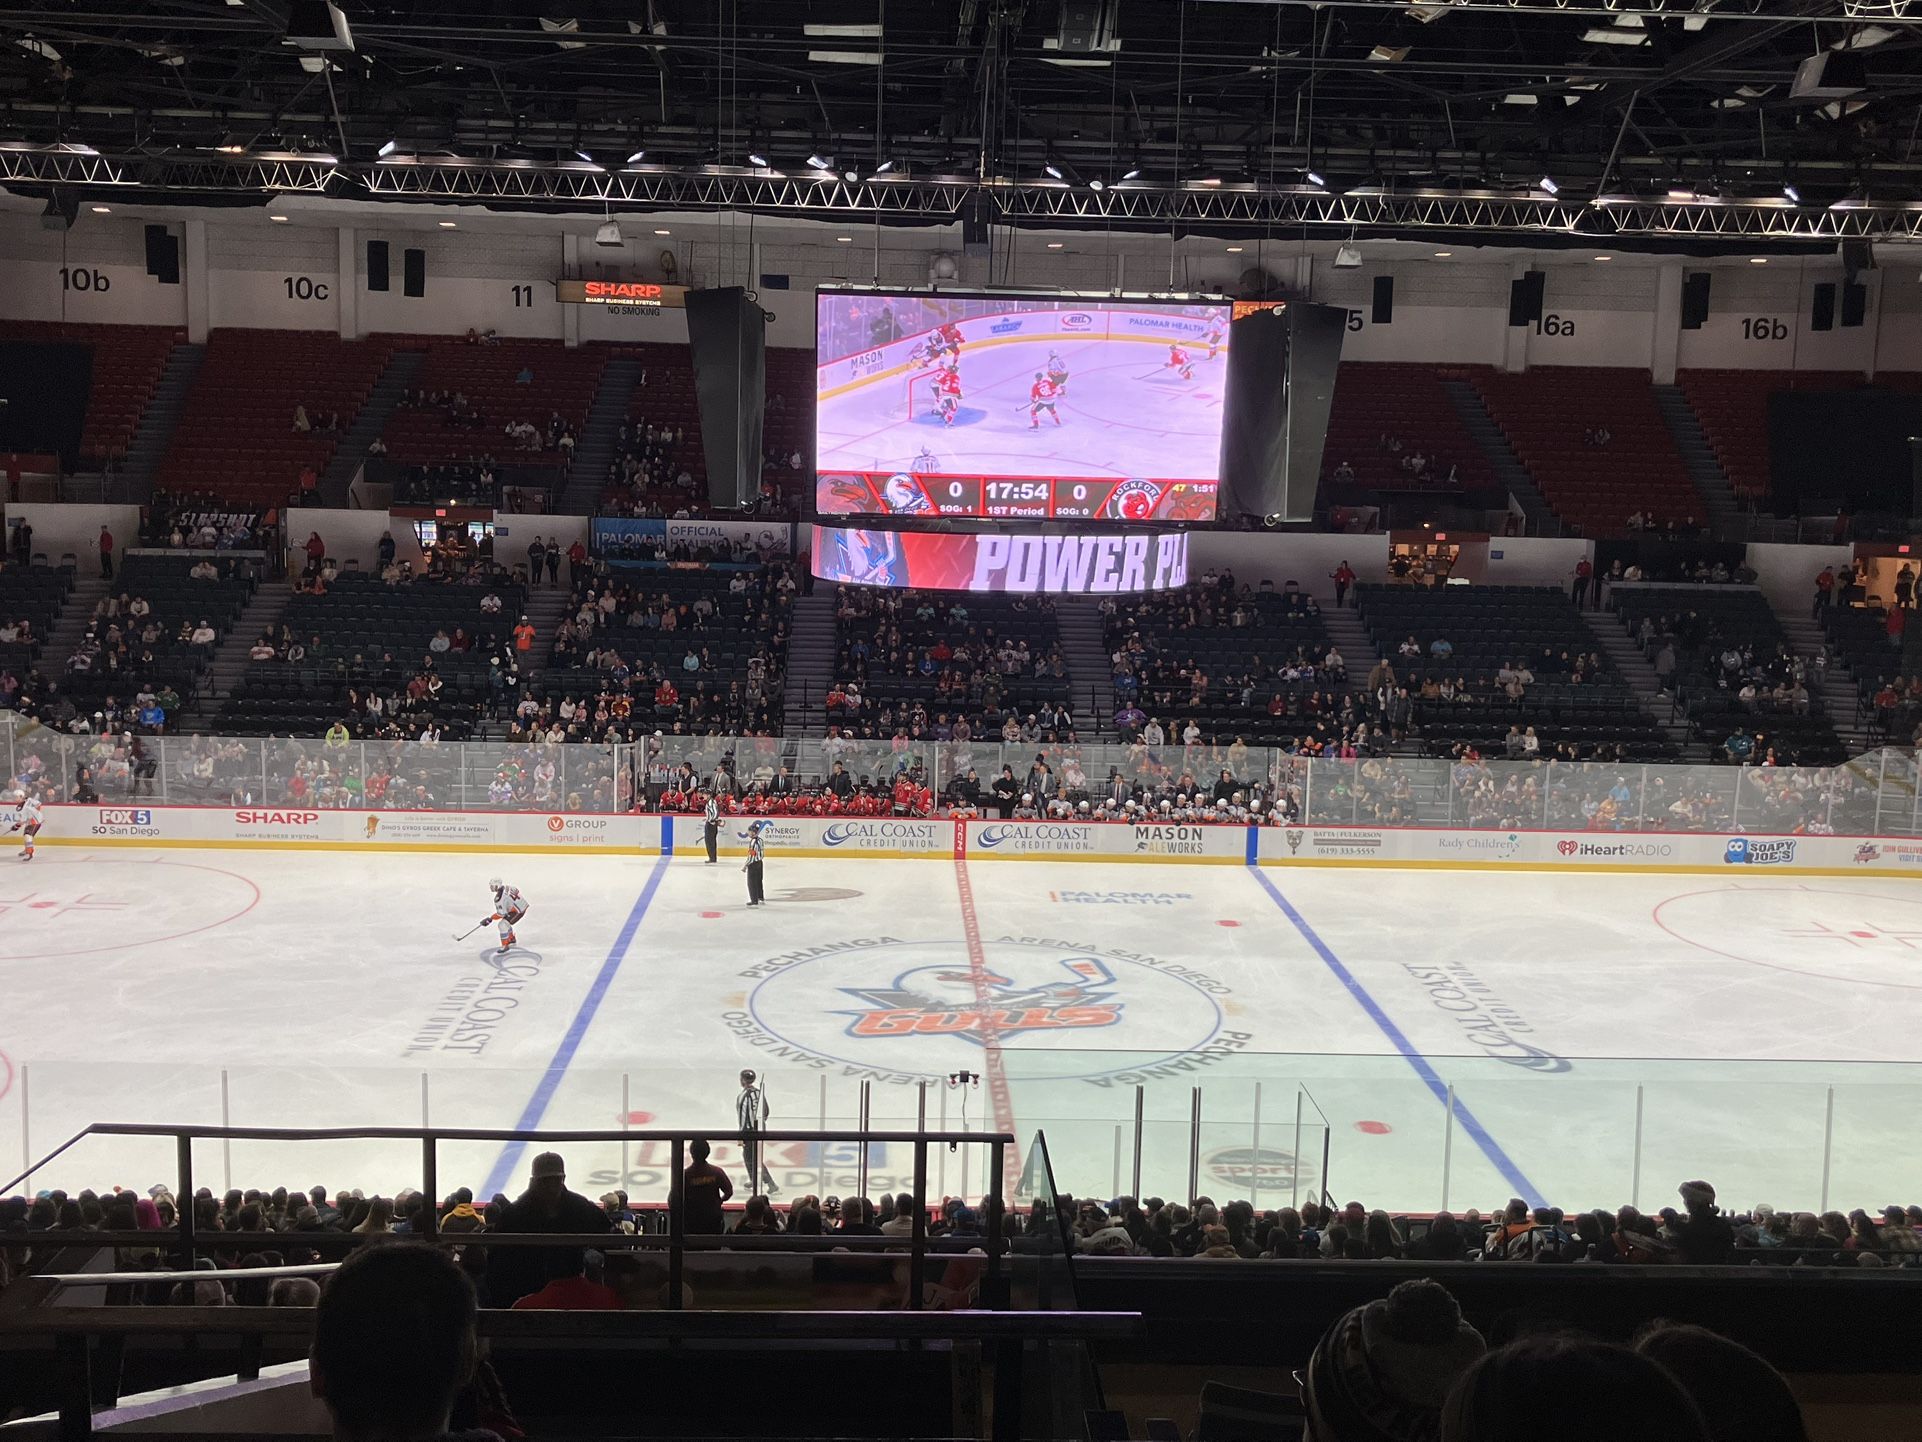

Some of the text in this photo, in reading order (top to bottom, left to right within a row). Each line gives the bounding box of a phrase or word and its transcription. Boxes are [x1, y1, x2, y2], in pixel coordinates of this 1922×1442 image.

[59, 268, 110, 292] 10b
[283, 277, 329, 300] 10c
[511, 285, 532, 307] 11
[585, 281, 661, 297] SHARP
[607, 306, 660, 316] NO SMOKING
[1129, 318, 1204, 332] PALOMAR HEALTH
[1347, 309, 1363, 331] 5
[1536, 314, 1575, 336] 16a
[1741, 317, 1788, 340] 16b
[850, 350, 883, 369] MASON
[949, 481, 963, 498] 0
[986, 481, 1049, 500] 17:54
[1072, 484, 1087, 500] 0
[1172, 484, 1186, 492] 47
[939, 504, 973, 513] SOG: 1
[987, 506, 1044, 515] 1ST Period
[1056, 507, 1089, 516] SOG: 0
[670, 526, 724, 537] OFFICIAL
[969, 535, 1149, 591] POWER
[101, 810, 147, 824] FOX 5
[235, 811, 319, 824] SHARP
[566, 820, 607, 828] GROUP
[92, 826, 160, 837] SO San Diego
[549, 834, 573, 842] signs
[583, 834, 604, 842] print
[846, 822, 936, 838] CAL COAST
[1001, 824, 1091, 840] CAL COAST
[1135, 827, 1203, 840] MASON
[860, 839, 933, 848] CREDIT UNION
[1015, 841, 1088, 850] CREDIT UNION
[1148, 842, 1203, 854] ALEWORKS
[1439, 838, 1464, 849] Rady
[1580, 843, 1672, 857] iHeartRADIO
[1750, 840, 1794, 852] SOAPY
[1753, 850, 1791, 862] JOE'S
[1060, 891, 1192, 899] PALOMAR
[738, 936, 904, 979] PECHANGA
[997, 936, 1232, 995] ARENA SAN DIEGO
[441, 965, 539, 1055] CAL COAST
[1402, 963, 1514, 1046] CAL COAST
[407, 977, 483, 1050] CREDIT UNION
[1478, 997, 1534, 1033] CREDIT
[721, 1011, 778, 1047] DIEGO
[768, 1045, 835, 1069] SAN
[1082, 1029, 1253, 1088] PECHANGA
[586, 1170, 663, 1186] SO
